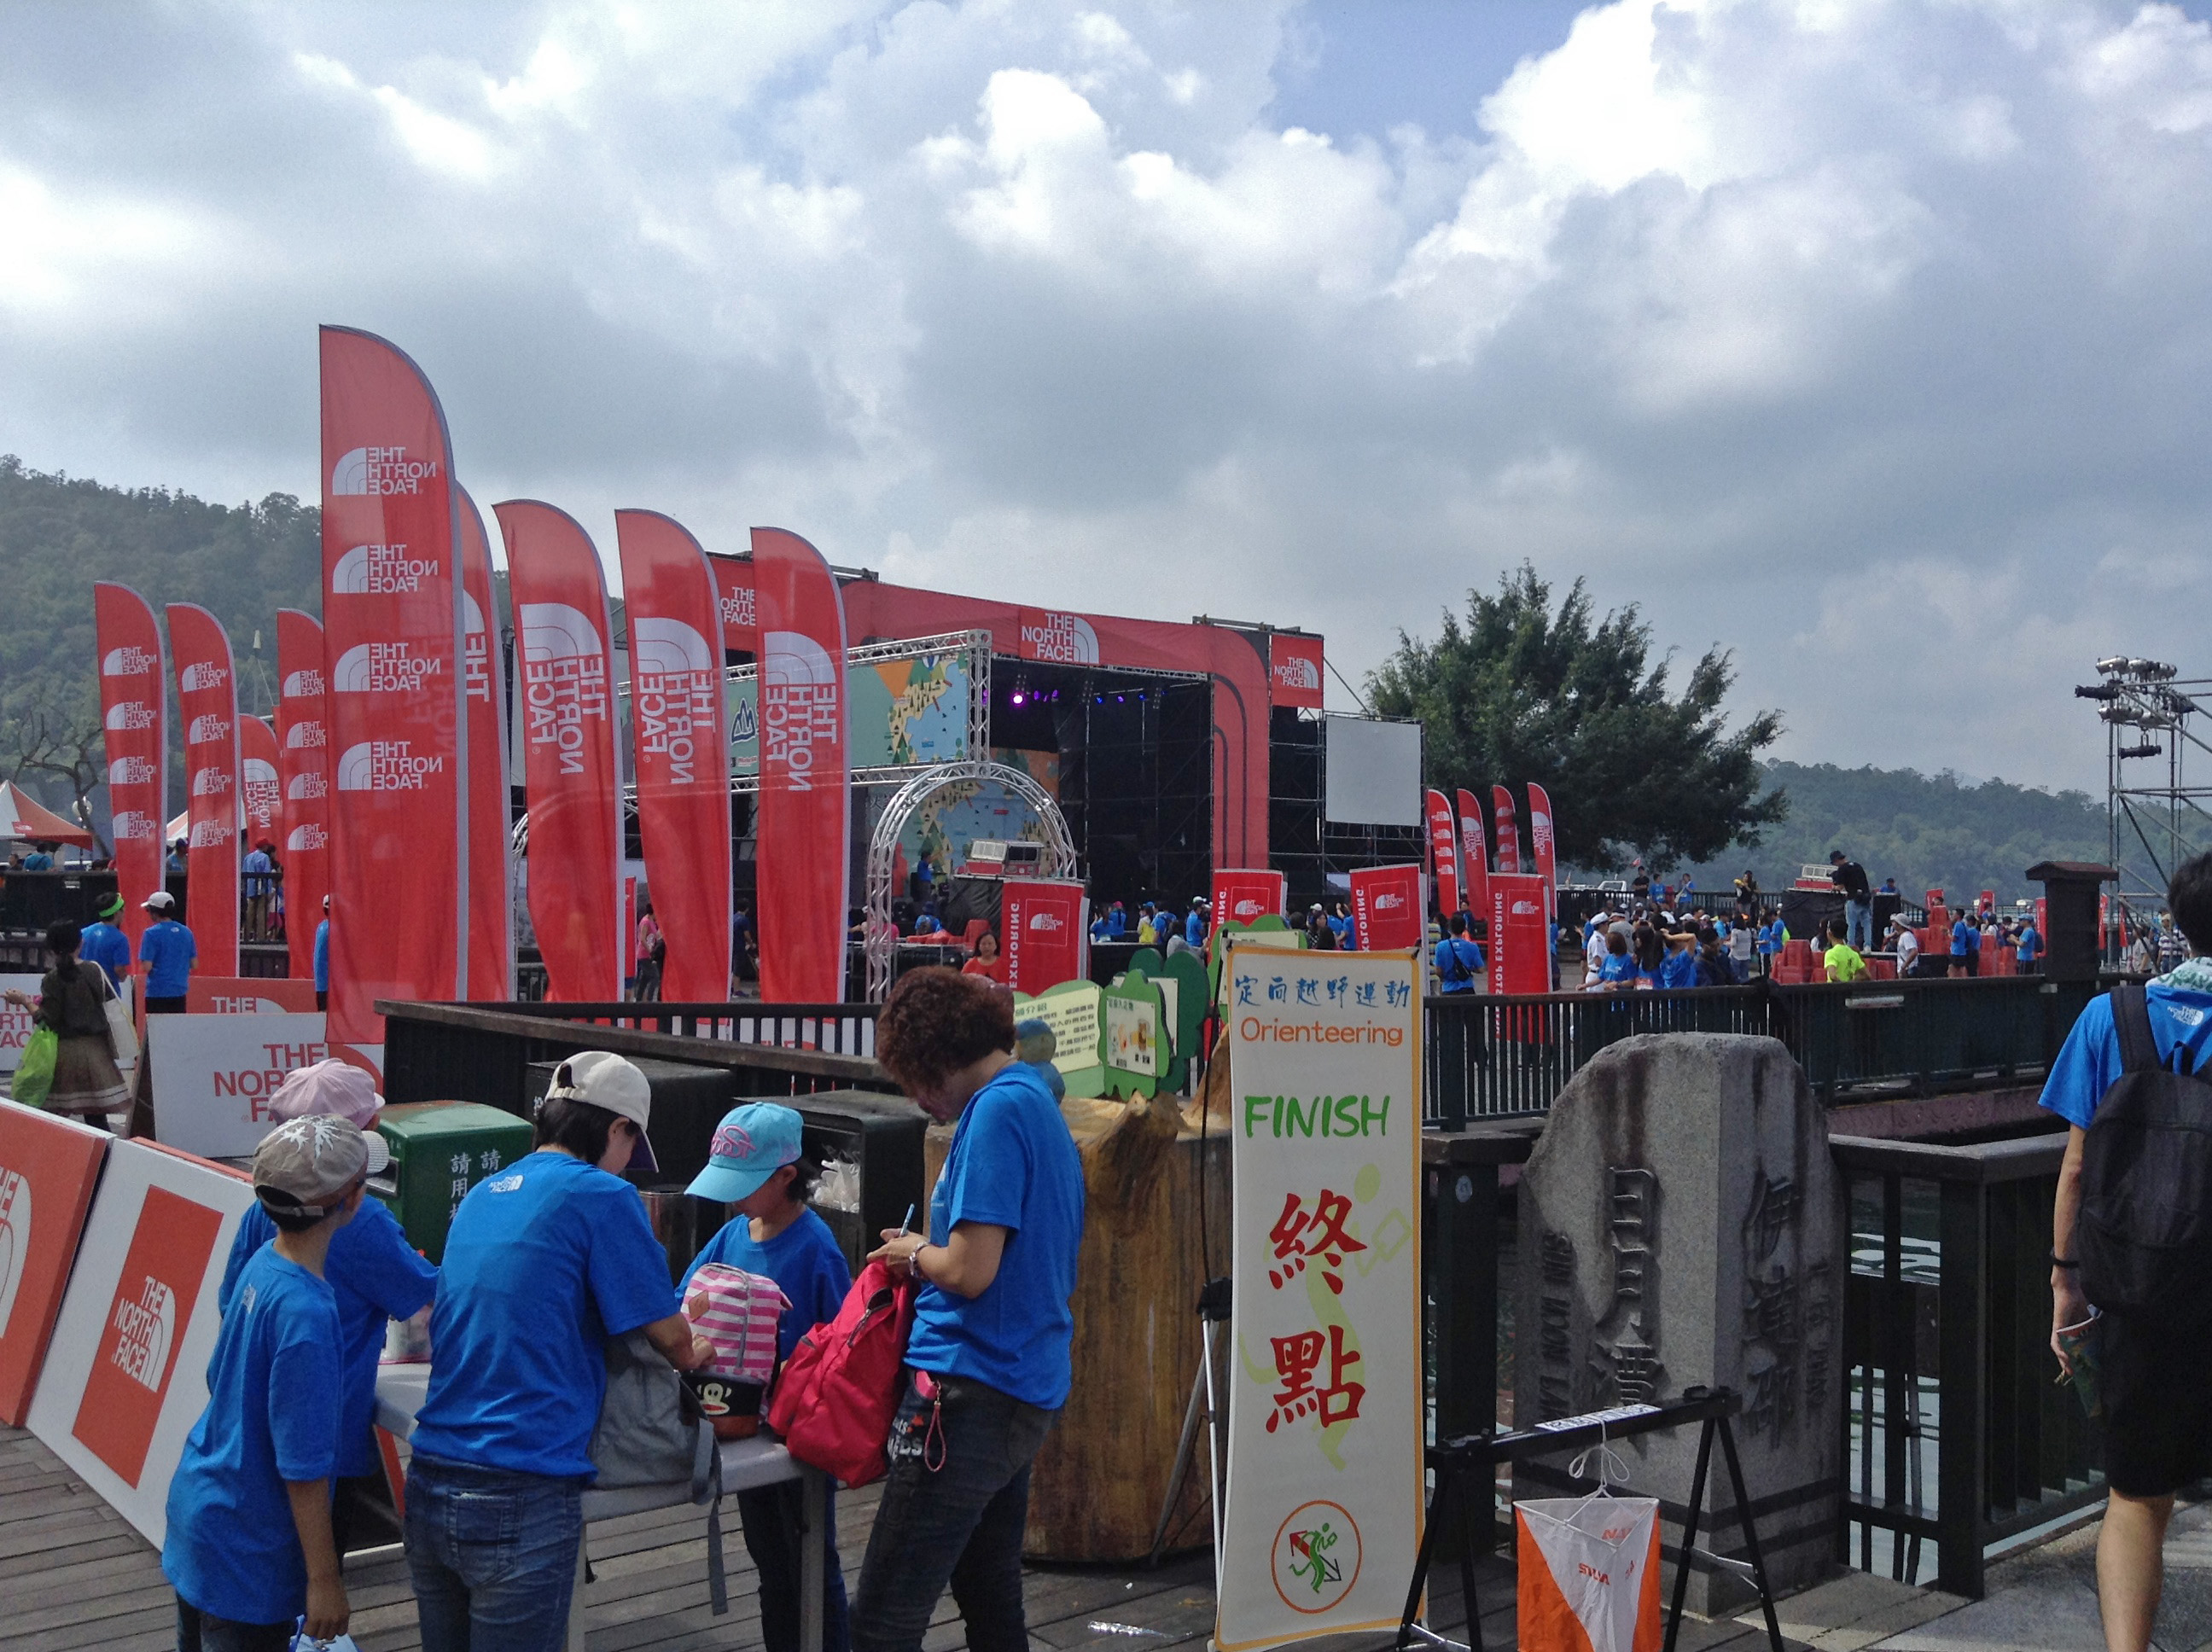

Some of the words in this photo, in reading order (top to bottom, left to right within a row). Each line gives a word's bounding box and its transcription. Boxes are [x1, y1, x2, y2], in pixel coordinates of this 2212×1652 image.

[732, 587, 755, 599] THE
[720, 598, 755, 612] ORTH
[725, 611, 756, 626] FACE
[1045, 613, 1073, 631] THE
[1022, 625, 1074, 646] NORTH
[1037, 643, 1073, 661] FACE
[1287, 656, 1304, 667] THE
[1274, 665, 1304, 678] NORTH
[1283, 676, 1304, 688] FACE
[1235, 975, 1411, 1008] 定向越野運動
[212, 997, 255, 1013] THE
[0, 1031, 32, 1048] AC
[1240, 1016, 1403, 1046] Orienteering
[263, 1044, 324, 1068] THE
[214, 1070, 291, 1096] NOR
[1244, 1095, 1390, 1138] FINISH
[141, 1276, 167, 1314] THE
[114, 1298, 157, 1347] NORTH
[1266, 1189, 1368, 1434] 終點
[1541, 1295, 1570, 1365] MOON
[114, 1335, 147, 1377] FACE
[1540, 1375, 1570, 1422] LAK
[1579, 1562, 1610, 1585] SILVA
